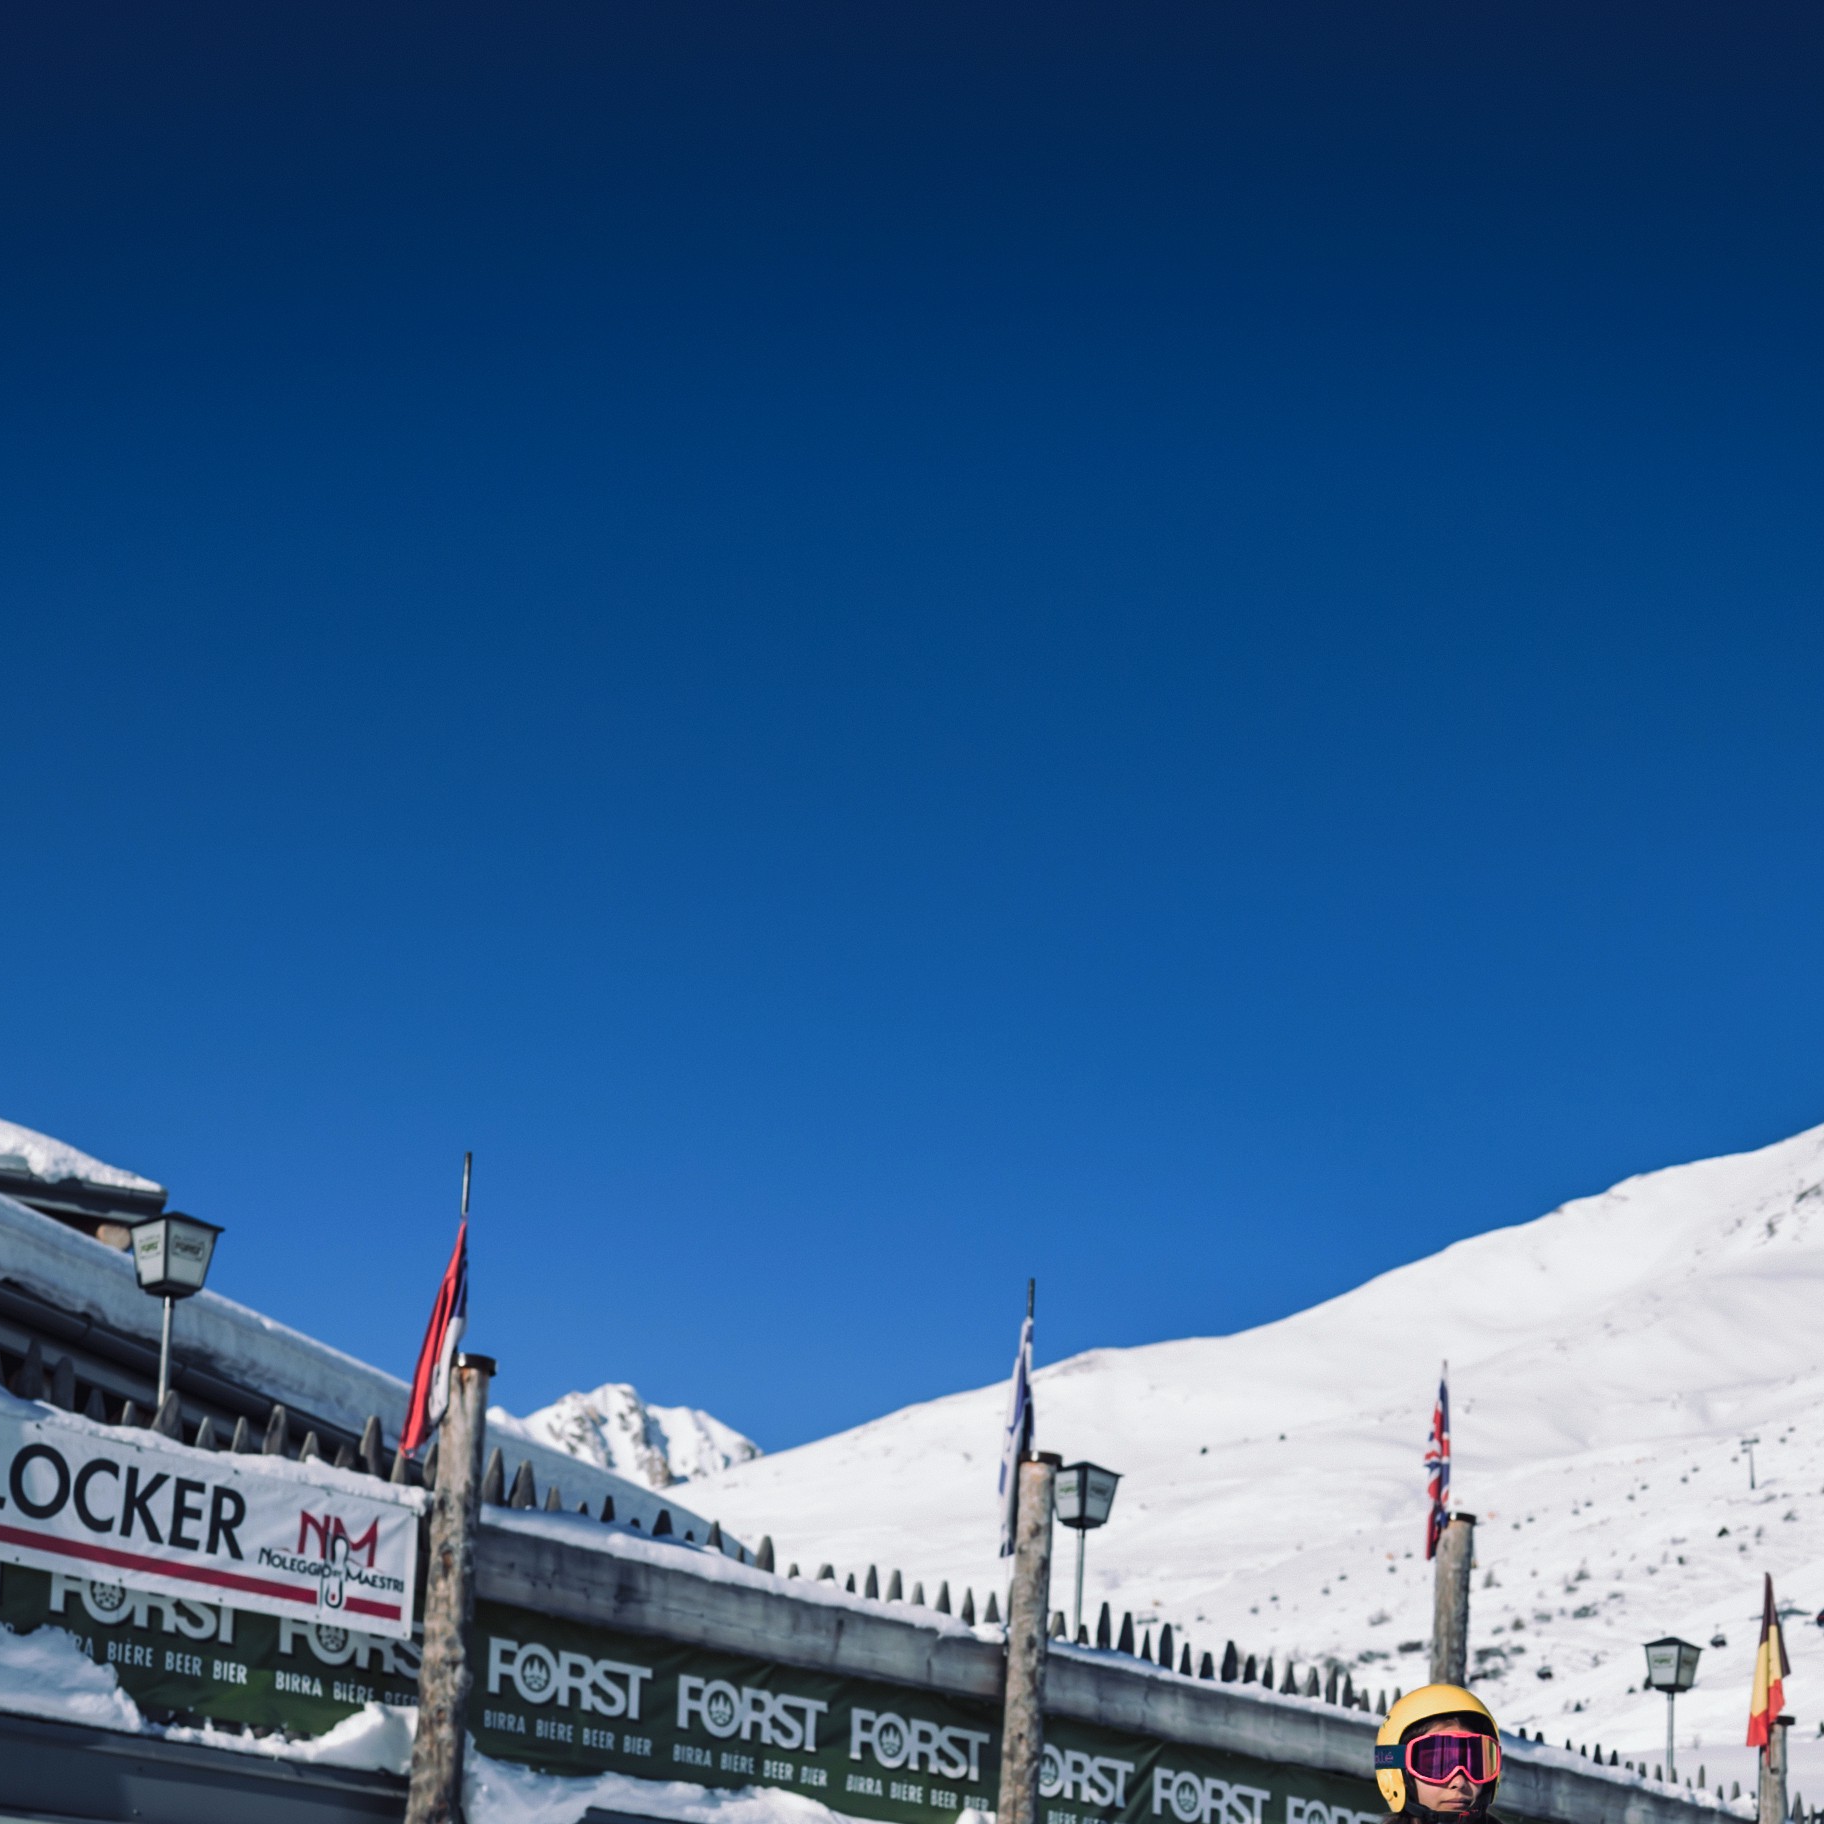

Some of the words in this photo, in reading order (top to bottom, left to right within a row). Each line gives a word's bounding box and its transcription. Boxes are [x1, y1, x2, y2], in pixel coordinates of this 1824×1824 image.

[165, 1651, 202, 1676] BEER
[212, 1660, 248, 1685] BIER
[279, 1618, 425, 1680] FORS
[275, 1671, 323, 1698] BIRRA
[487, 1636, 653, 1720] FORST
[483, 1709, 526, 1734] BIRRA
[582, 1727, 615, 1750] BEER
[623, 1735, 652, 1757] BIER
[677, 1674, 829, 1752] FORST
[672, 1743, 712, 1767] BIRRA
[763, 1759, 794, 1781] BEER
[800, 1766, 828, 1787] BIER
[849, 1707, 991, 1782] FORST
[845, 1774, 883, 1797] BIRRA
[930, 1789, 958, 1809] BEER
[1038, 1743, 1135, 1809] ORST
